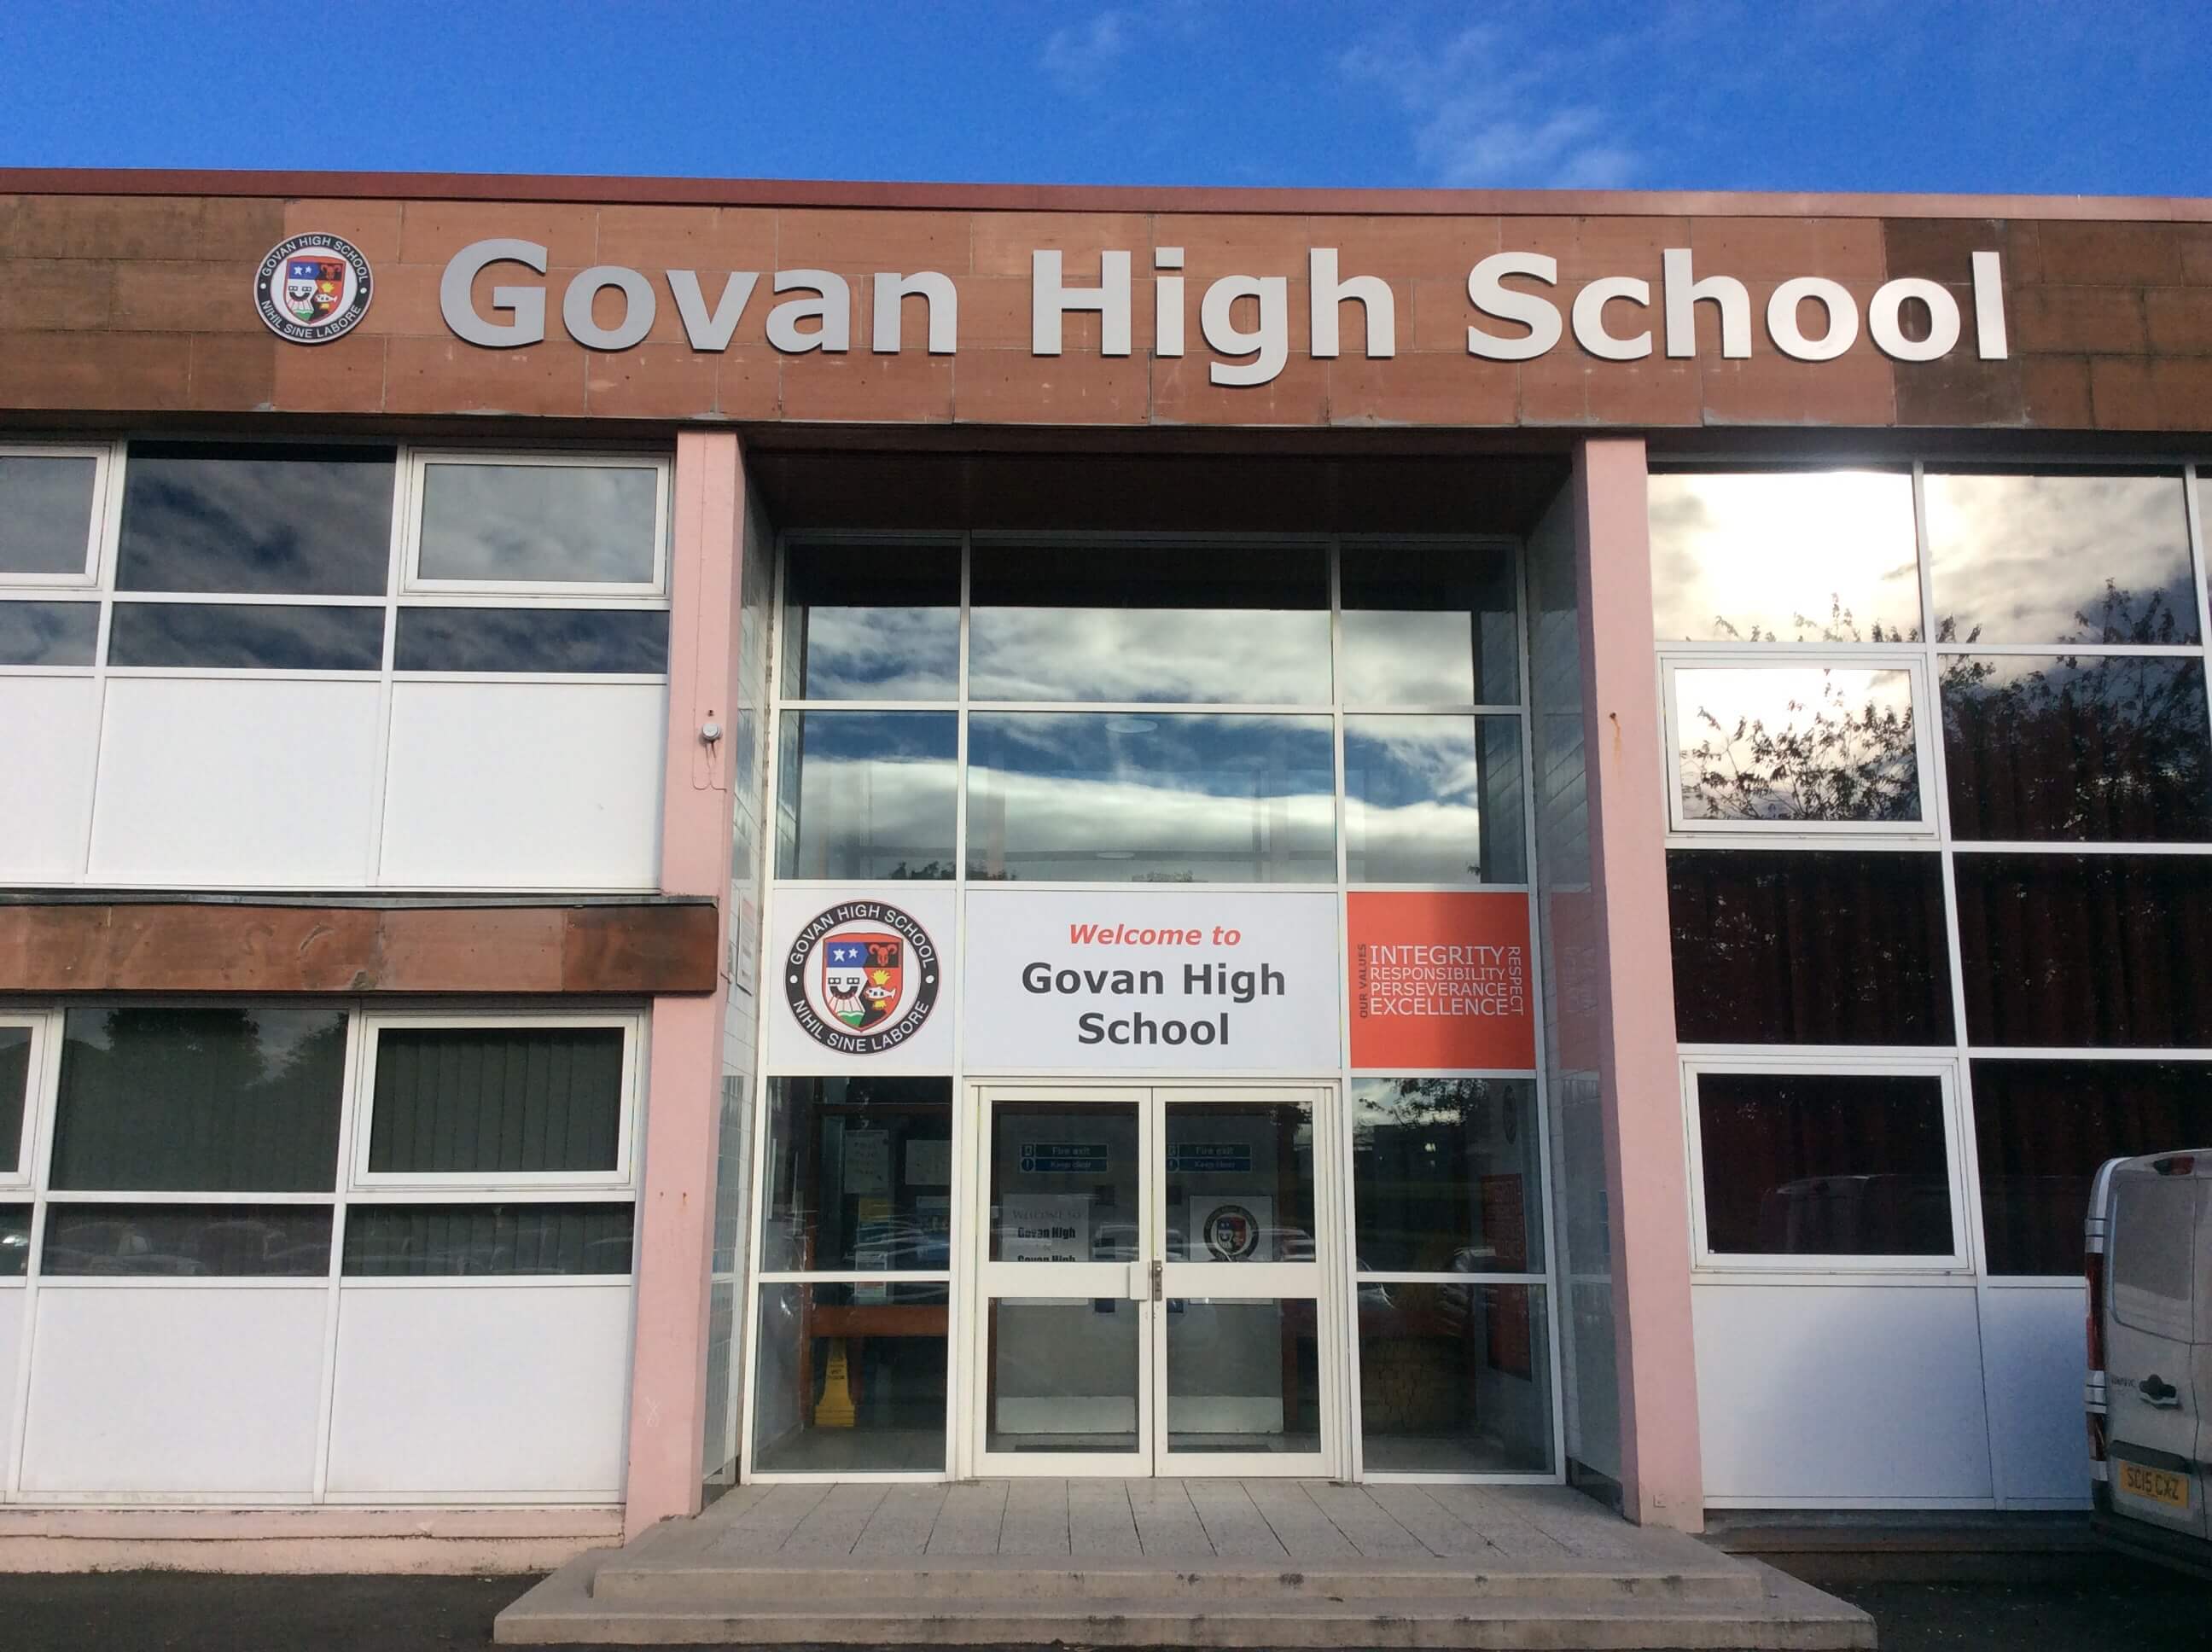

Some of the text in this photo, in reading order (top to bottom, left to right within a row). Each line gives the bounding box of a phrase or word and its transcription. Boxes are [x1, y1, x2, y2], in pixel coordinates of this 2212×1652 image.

[261, 236, 369, 283] GOVAN HIGH SCHOOL
[261, 300, 362, 339] NIHIL SINE LABORE
[439, 238, 2008, 387] Govan High School
[790, 905, 935, 969] GOVAN HIGH SCHOOL
[1068, 923, 1242, 946] Welcome to
[1370, 945, 1505, 965] INTEGRITY
[1022, 962, 1285, 1003] Govan High
[1357, 943, 1369, 1019] OUR VALUES
[1370, 967, 1505, 981] RESPONSIBILITY
[1371, 982, 1507, 997] PERSEVERANCE
[1507, 946, 1523, 1016] RESPECT
[793, 999, 929, 1052] NIHIL SINE LABORE
[1370, 998, 1509, 1016] EXCELLENCE
[1078, 1011, 1229, 1046] School
[1072, 1146, 1091, 1155] exit
[1017, 1226, 1076, 1240] Govan High
